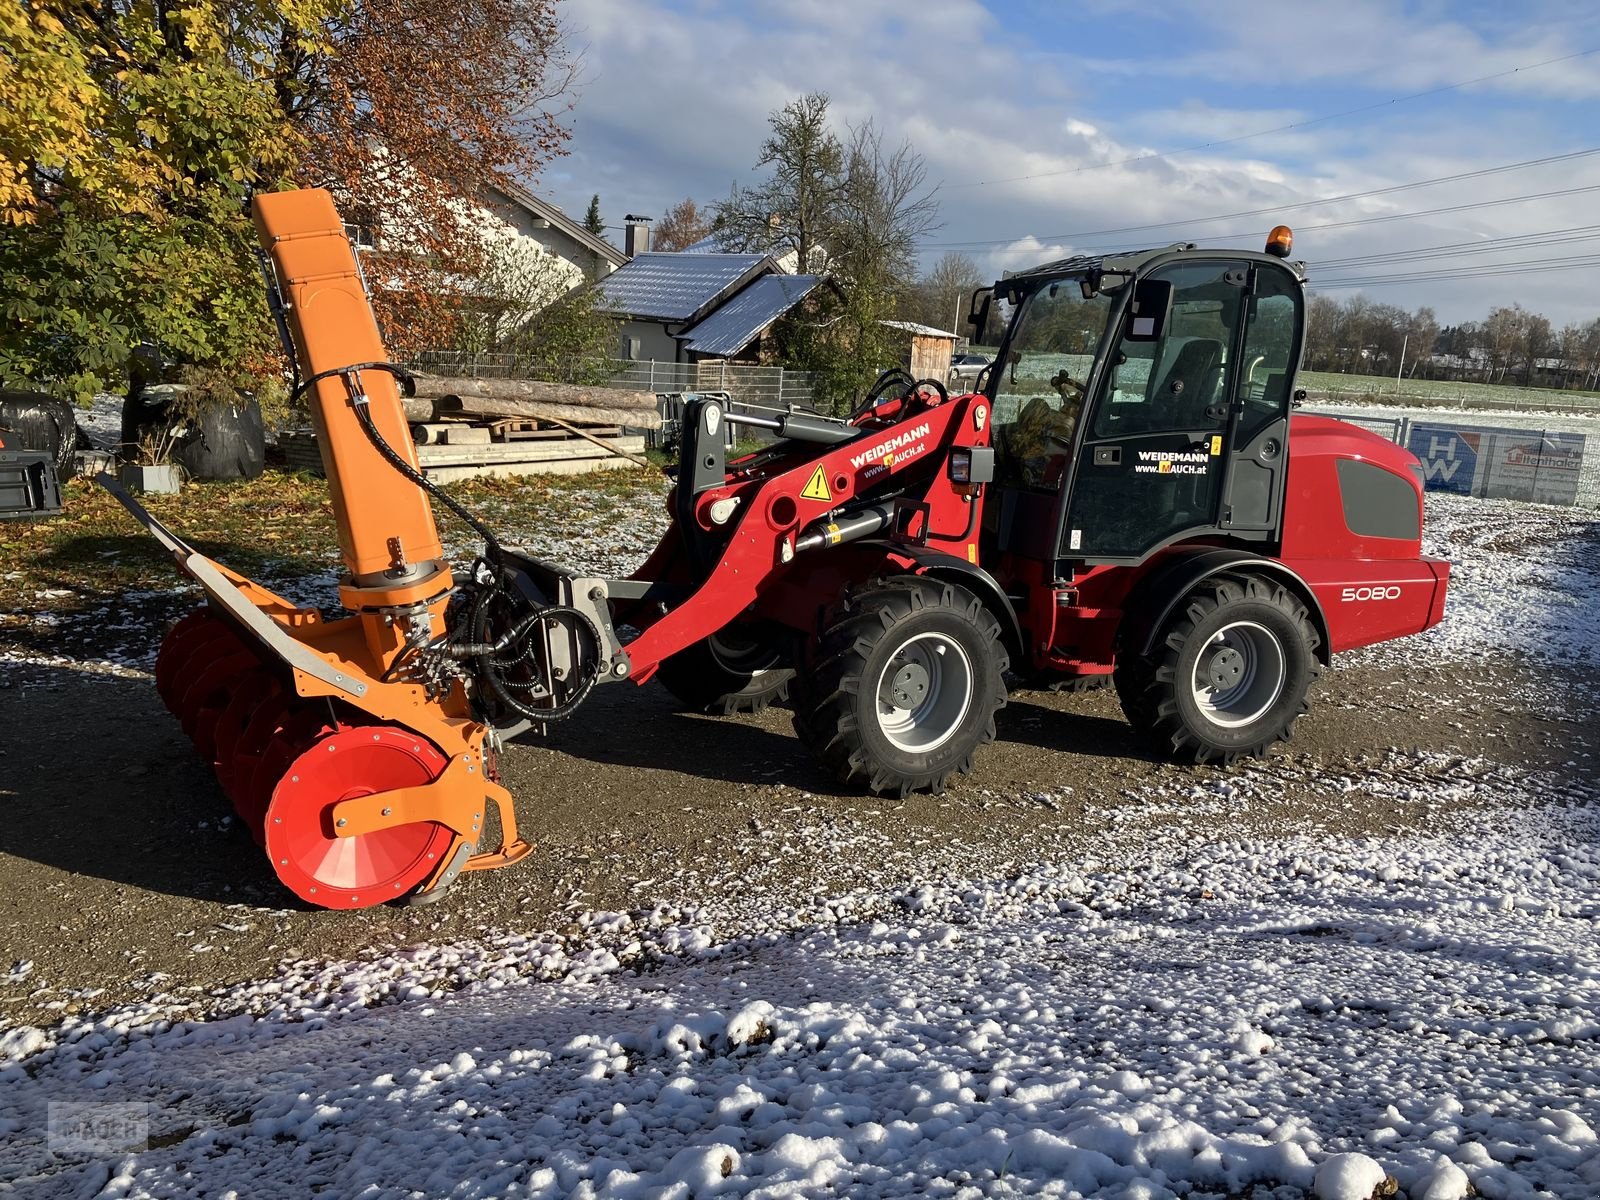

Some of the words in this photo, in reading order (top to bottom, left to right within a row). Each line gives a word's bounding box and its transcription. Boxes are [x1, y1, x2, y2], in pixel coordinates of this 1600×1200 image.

[850, 422, 930, 469] WEIDEMANN
[1428, 435, 1457, 461] H
[864, 442, 925, 479] www.MAUCH.at
[1138, 451, 1209, 463] WEIDEMANN
[1135, 462, 1207, 475] www.MAUCH.at
[1341, 586, 1401, 602] 5080
